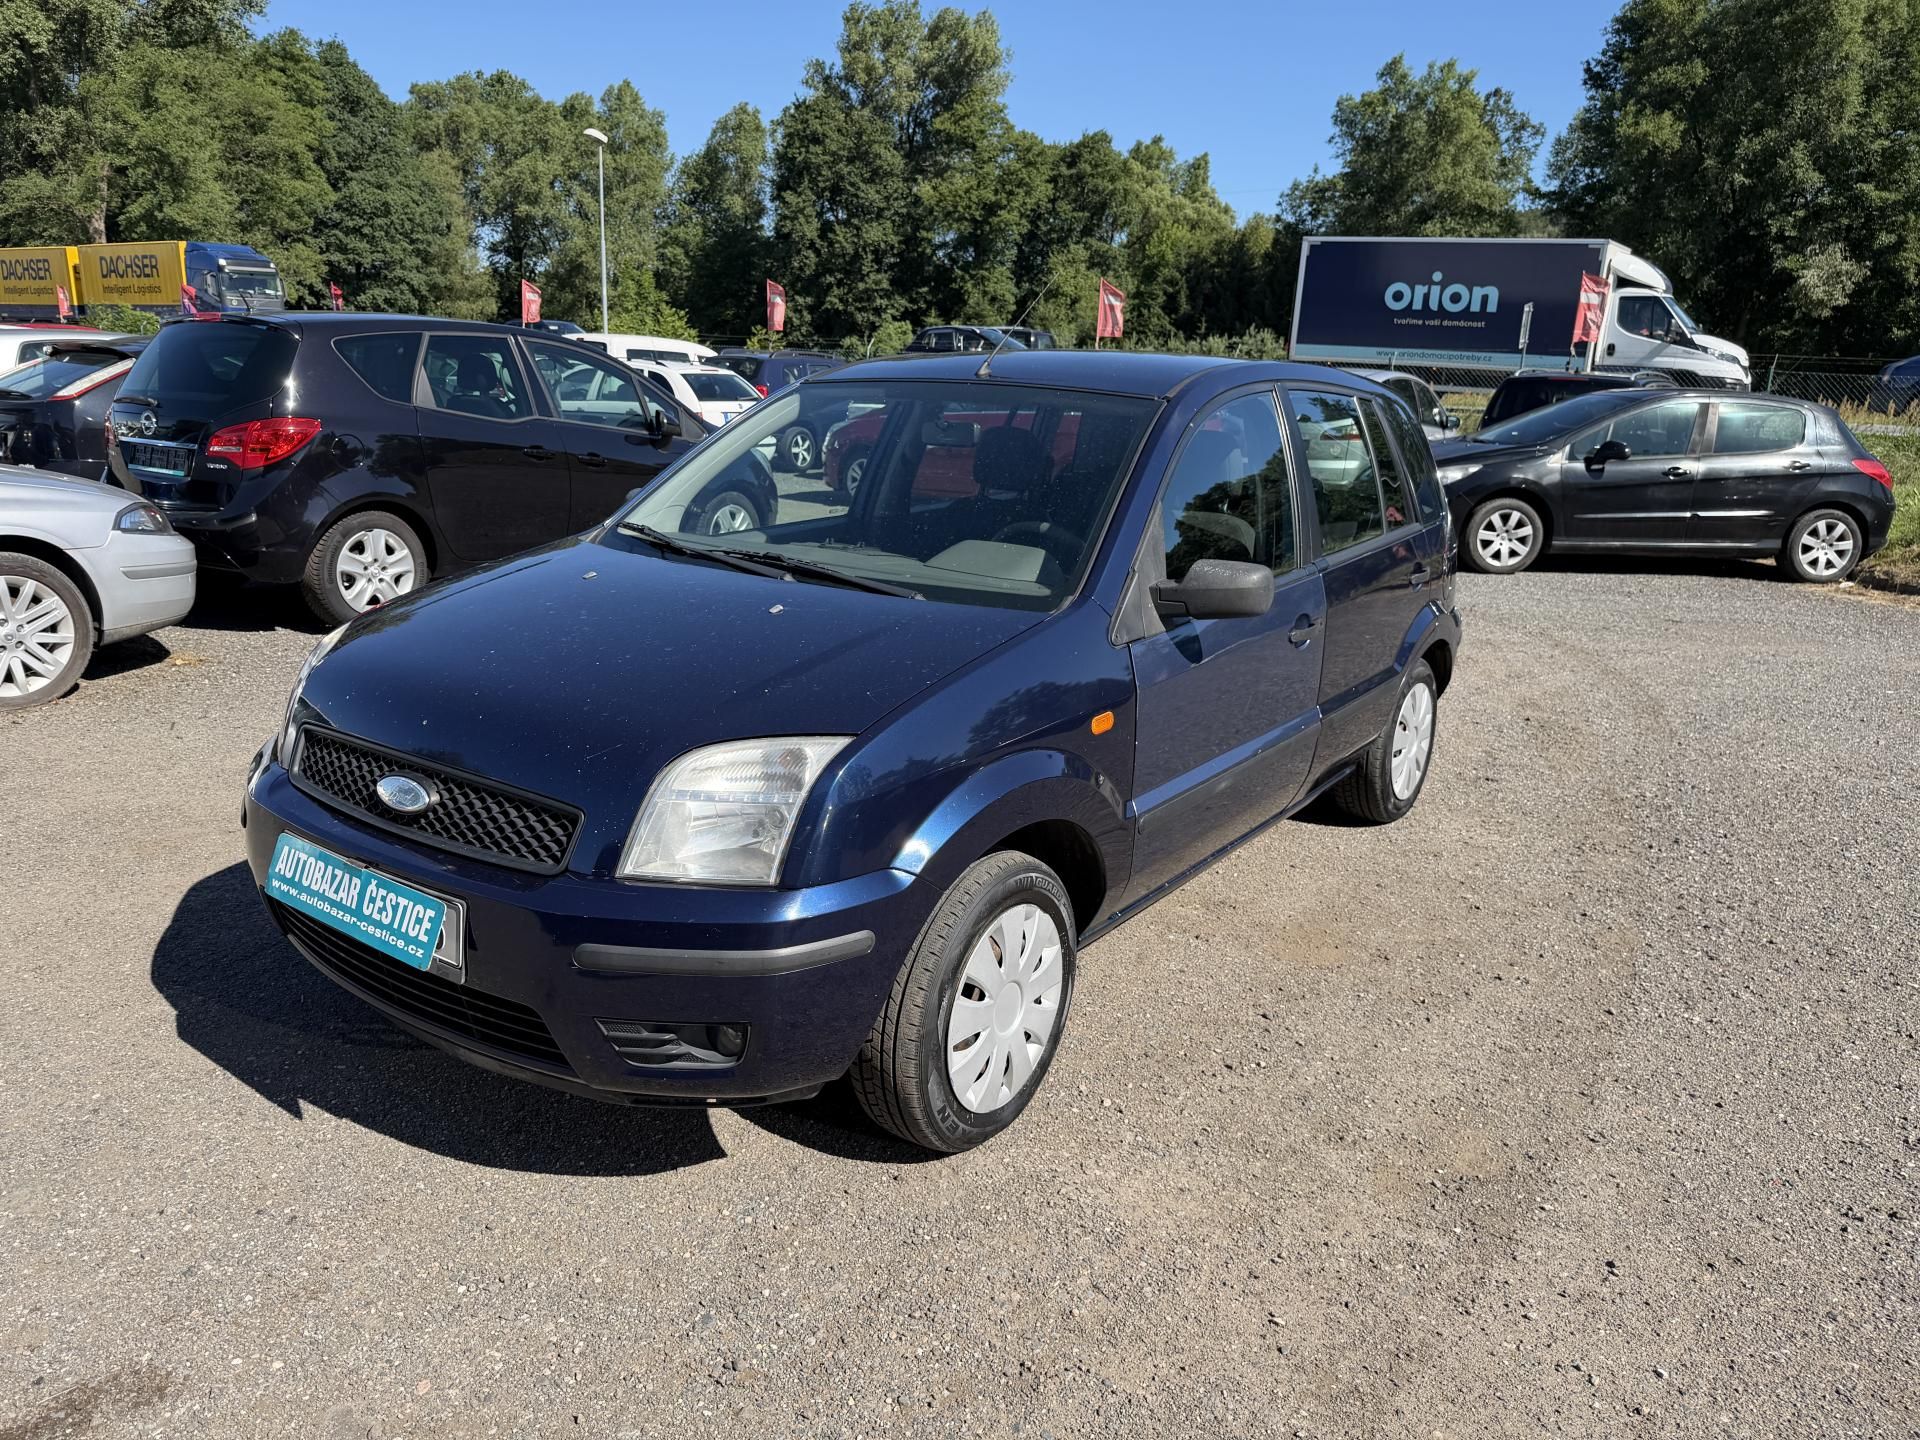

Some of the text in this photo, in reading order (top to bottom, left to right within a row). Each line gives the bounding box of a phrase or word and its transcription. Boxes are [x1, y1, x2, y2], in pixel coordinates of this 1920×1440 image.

[0, 258, 52, 280] DACHSER
[99, 254, 160, 279] DACHSER
[3, 286, 54, 296] Intelligent Logistics
[102, 283, 161, 297] Intelligent Logistics
[1384, 271, 1499, 313] orion
[1376, 350, 1492, 362] wwworiondomacipotreby.cz
[274, 845, 436, 943] AUTOBAZAR ČESTICE
[271, 877, 425, 958] www.autobazar-cestice.cz
